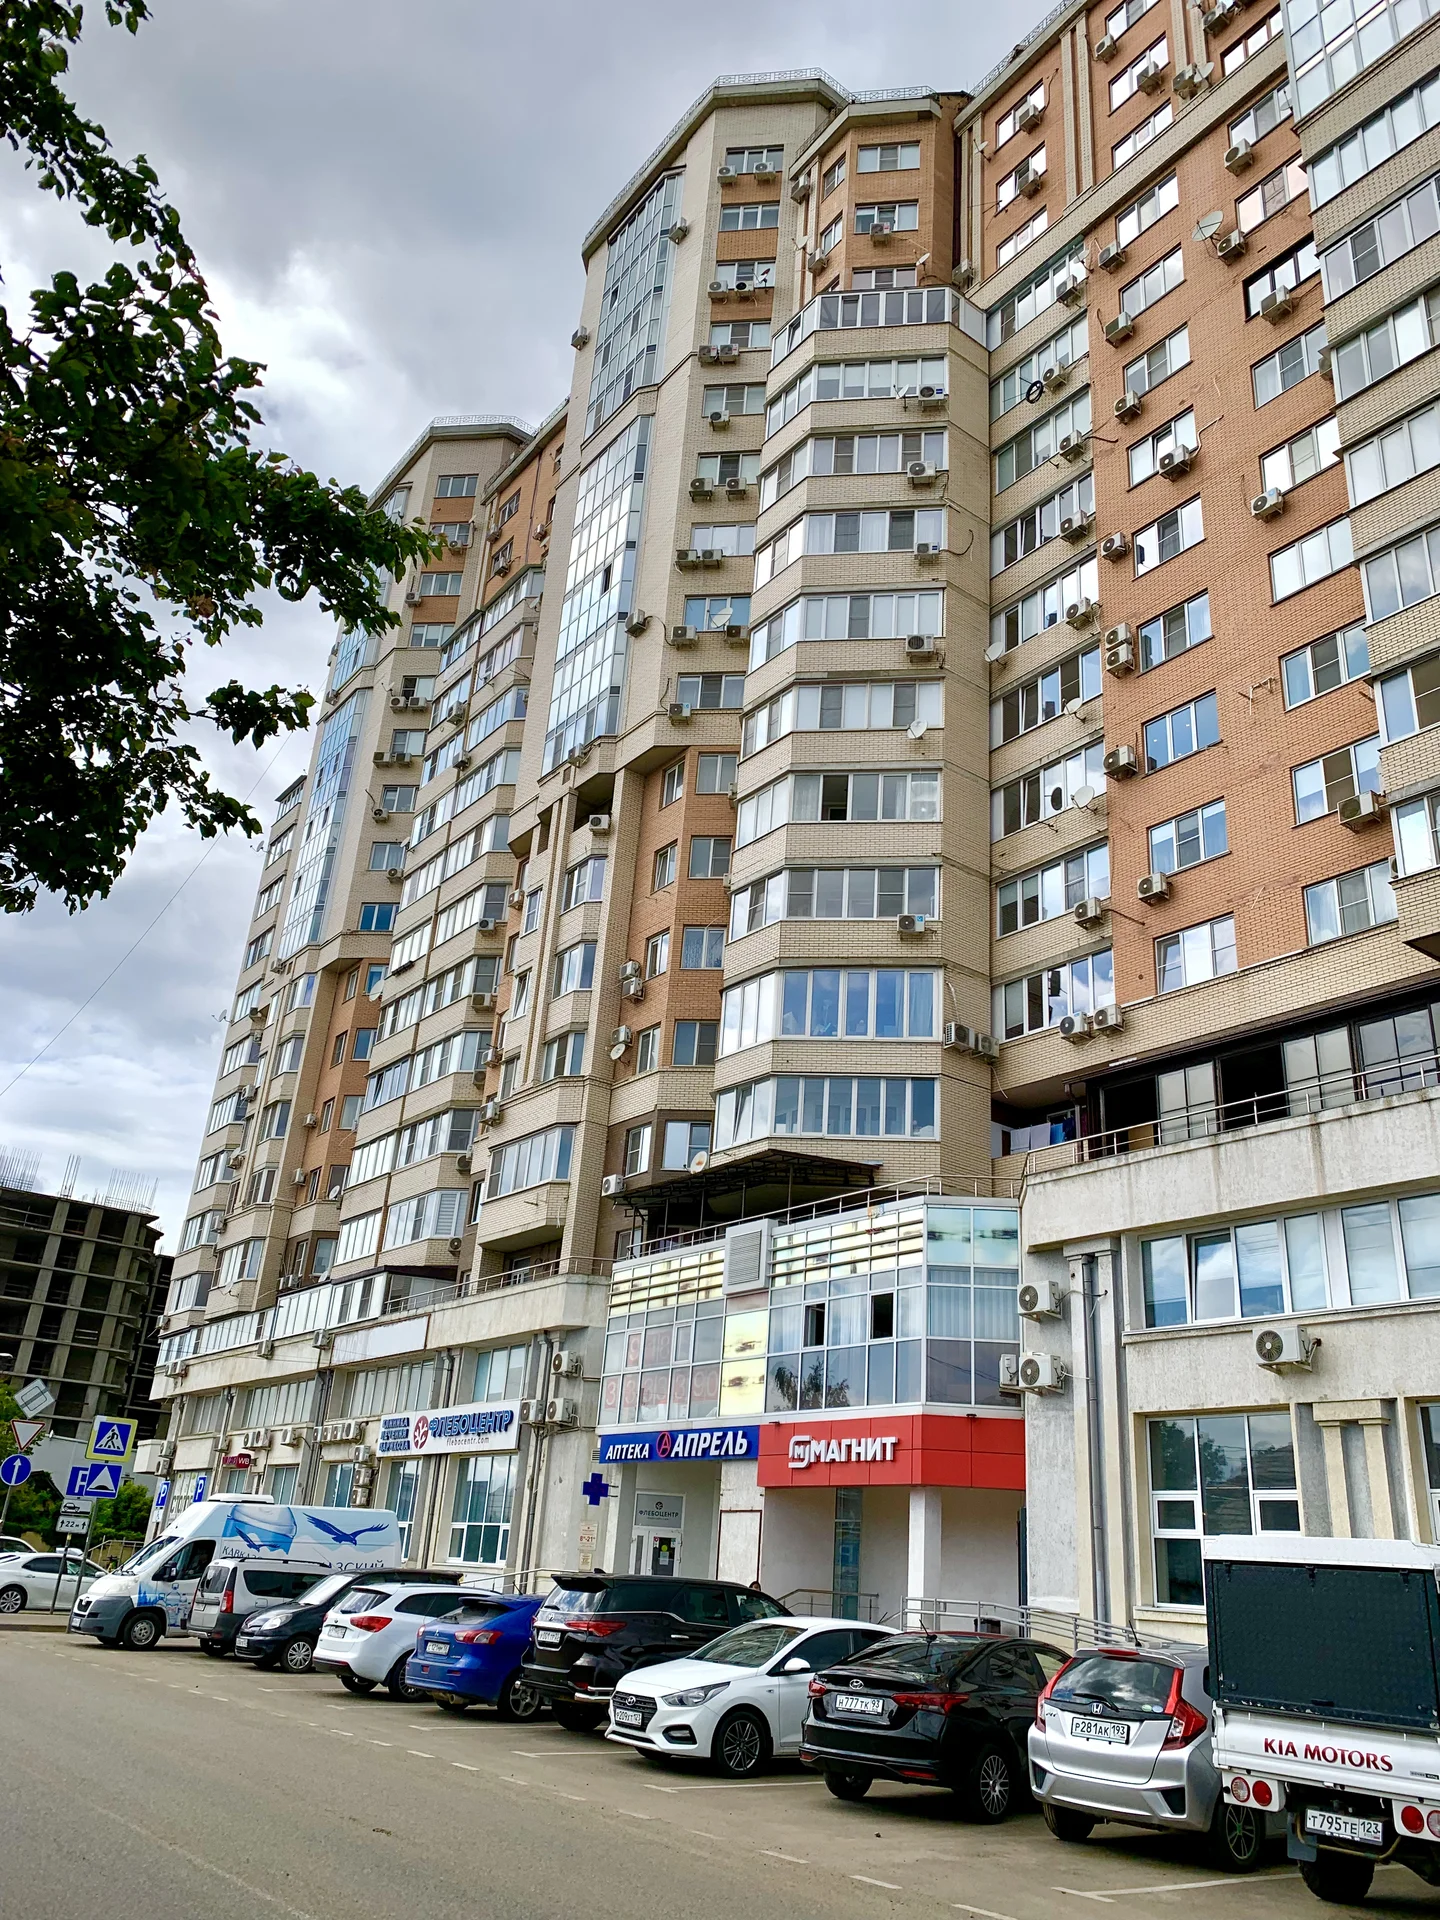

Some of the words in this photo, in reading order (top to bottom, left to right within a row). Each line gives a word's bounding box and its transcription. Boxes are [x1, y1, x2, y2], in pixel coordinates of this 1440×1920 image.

[429, 1410, 513, 1437] ФЛЕБОЦЕНТР
[446, 1437, 490, 1447] flebocentr.com
[605, 1443, 649, 1460] АПТЕКА
[670, 1430, 748, 1458] АПРЕЛЬ
[810, 1436, 898, 1463] МАГНИТ
[638, 1510, 679, 1518] ФЛЕБОЦЕНТР
[1264, 1737, 1298, 1758] KIA
[1304, 1743, 1393, 1772] MOTORS
